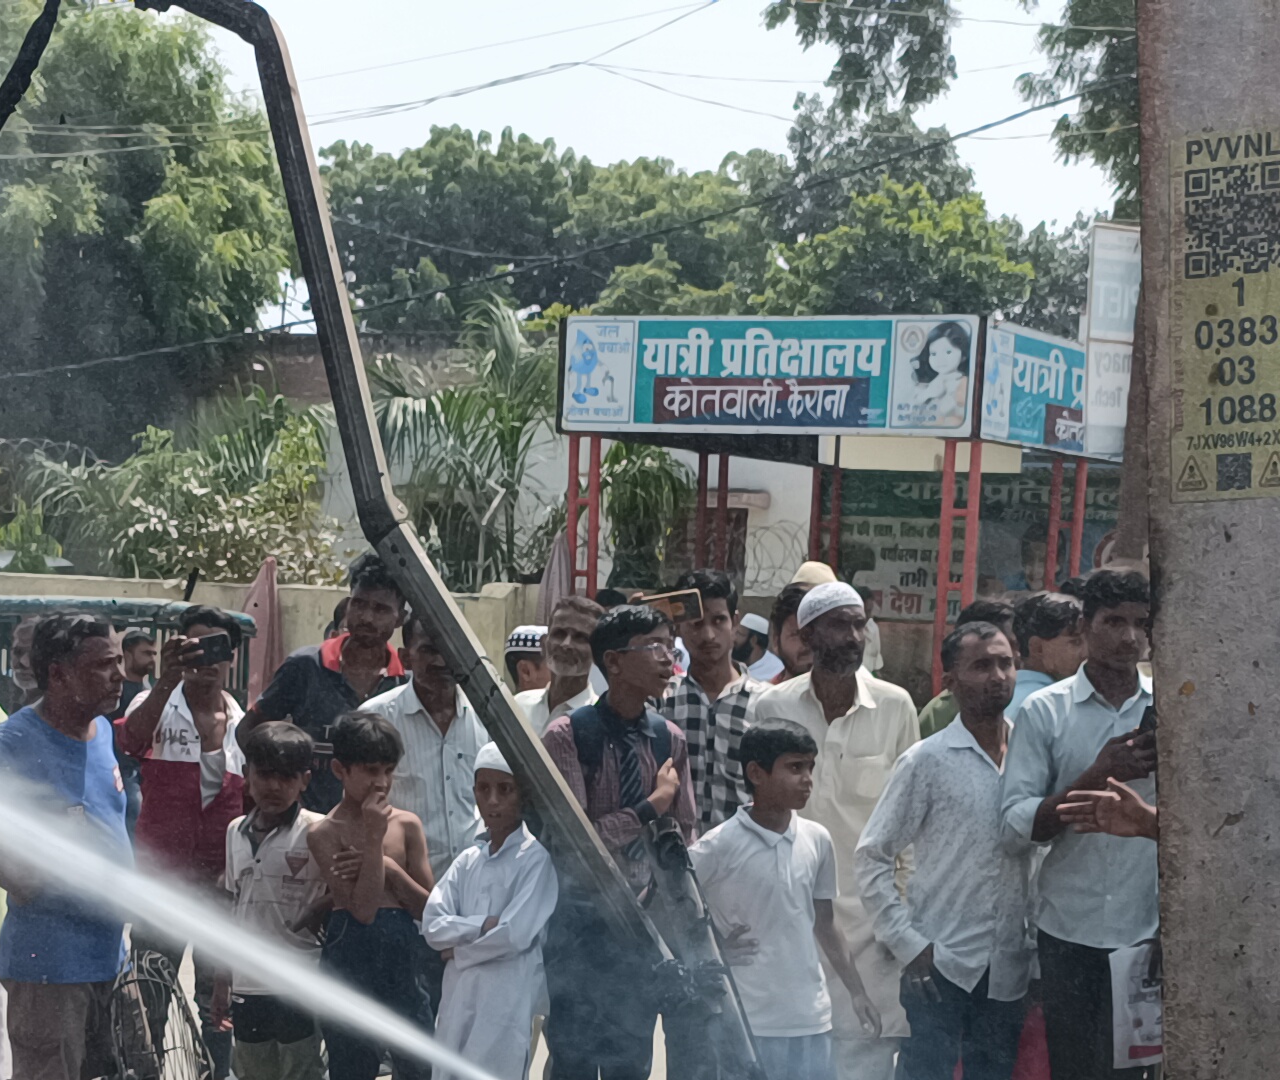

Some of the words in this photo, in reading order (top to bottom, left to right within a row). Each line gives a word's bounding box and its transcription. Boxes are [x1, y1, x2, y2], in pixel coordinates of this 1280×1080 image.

[1232, 277, 1246, 307] 1
[1194, 315, 1278, 350] 0383
[642, 327, 714, 376] यात्री
[720, 327, 886, 378] प्रतिक्षालय
[1014, 349, 1067, 400] यात्री
[1218, 355, 1256, 386] 03
[785, 378, 850, 419] कैराना
[1199, 393, 1277, 426] 1088
[889, 585, 924, 615] देश
